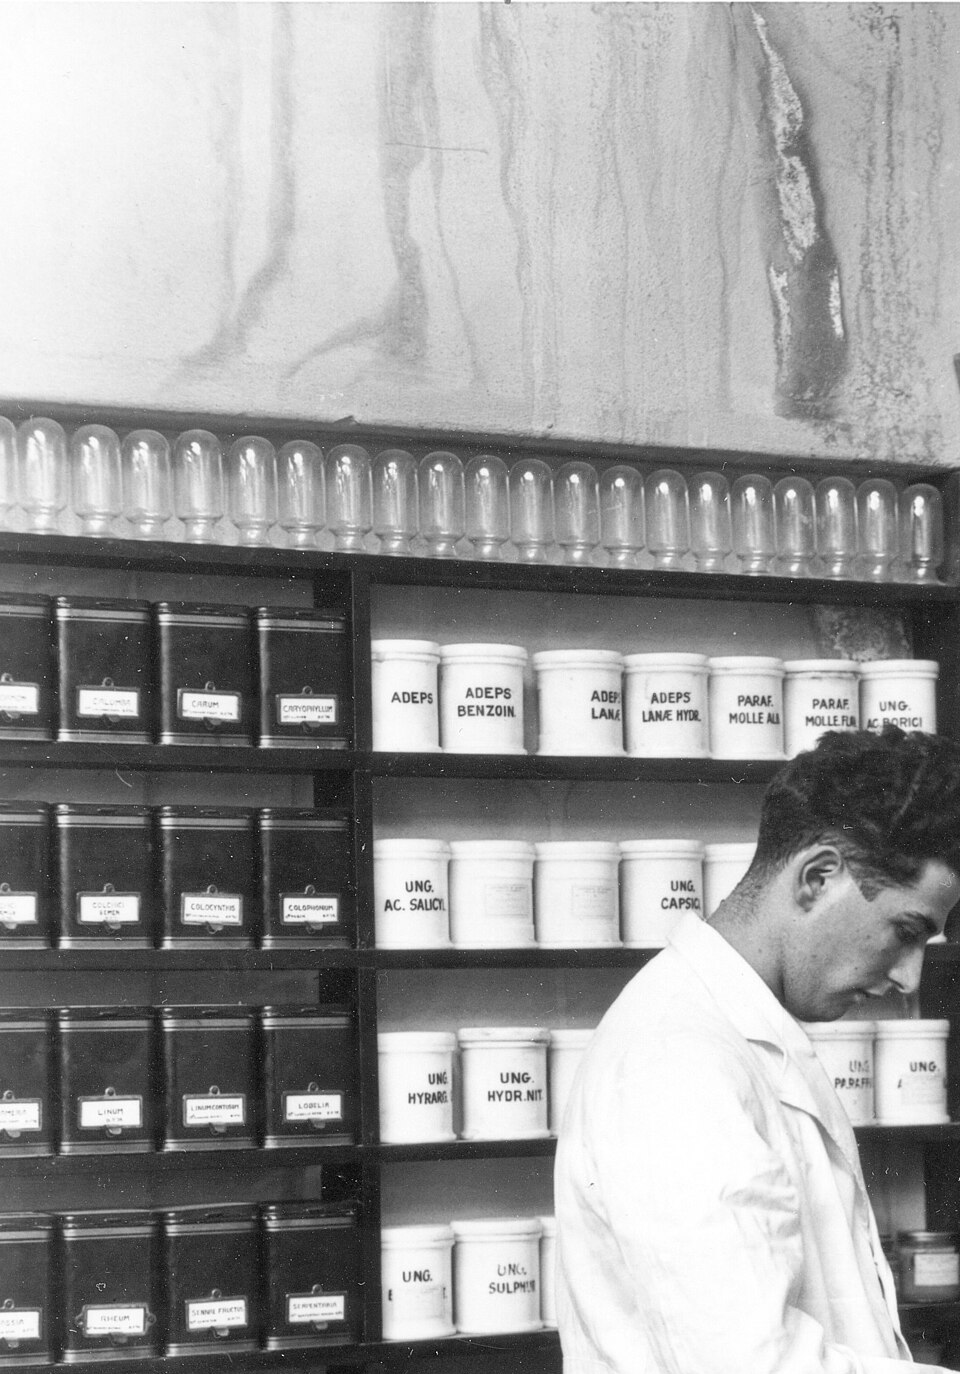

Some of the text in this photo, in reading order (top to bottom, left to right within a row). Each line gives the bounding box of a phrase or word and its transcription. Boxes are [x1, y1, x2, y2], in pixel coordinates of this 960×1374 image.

[391, 691, 434, 704] ADEPS
[465, 687, 512, 699] ADEPS
[650, 691, 691, 704] ADEPS
[737, 695, 774, 707] PARAF.
[812, 698, 849, 710] PARAF.
[879, 700, 911, 712] UNG.
[729, 712, 764, 724] MOLLE
[405, 880, 434, 893] UNG.
[384, 899, 406, 912] AC.
[909, 1061, 940, 1072] UNG.
[428, 1072, 448, 1085] UNG.
[500, 1072, 535, 1084] UNG.
[402, 1269, 432, 1282] UNG.
